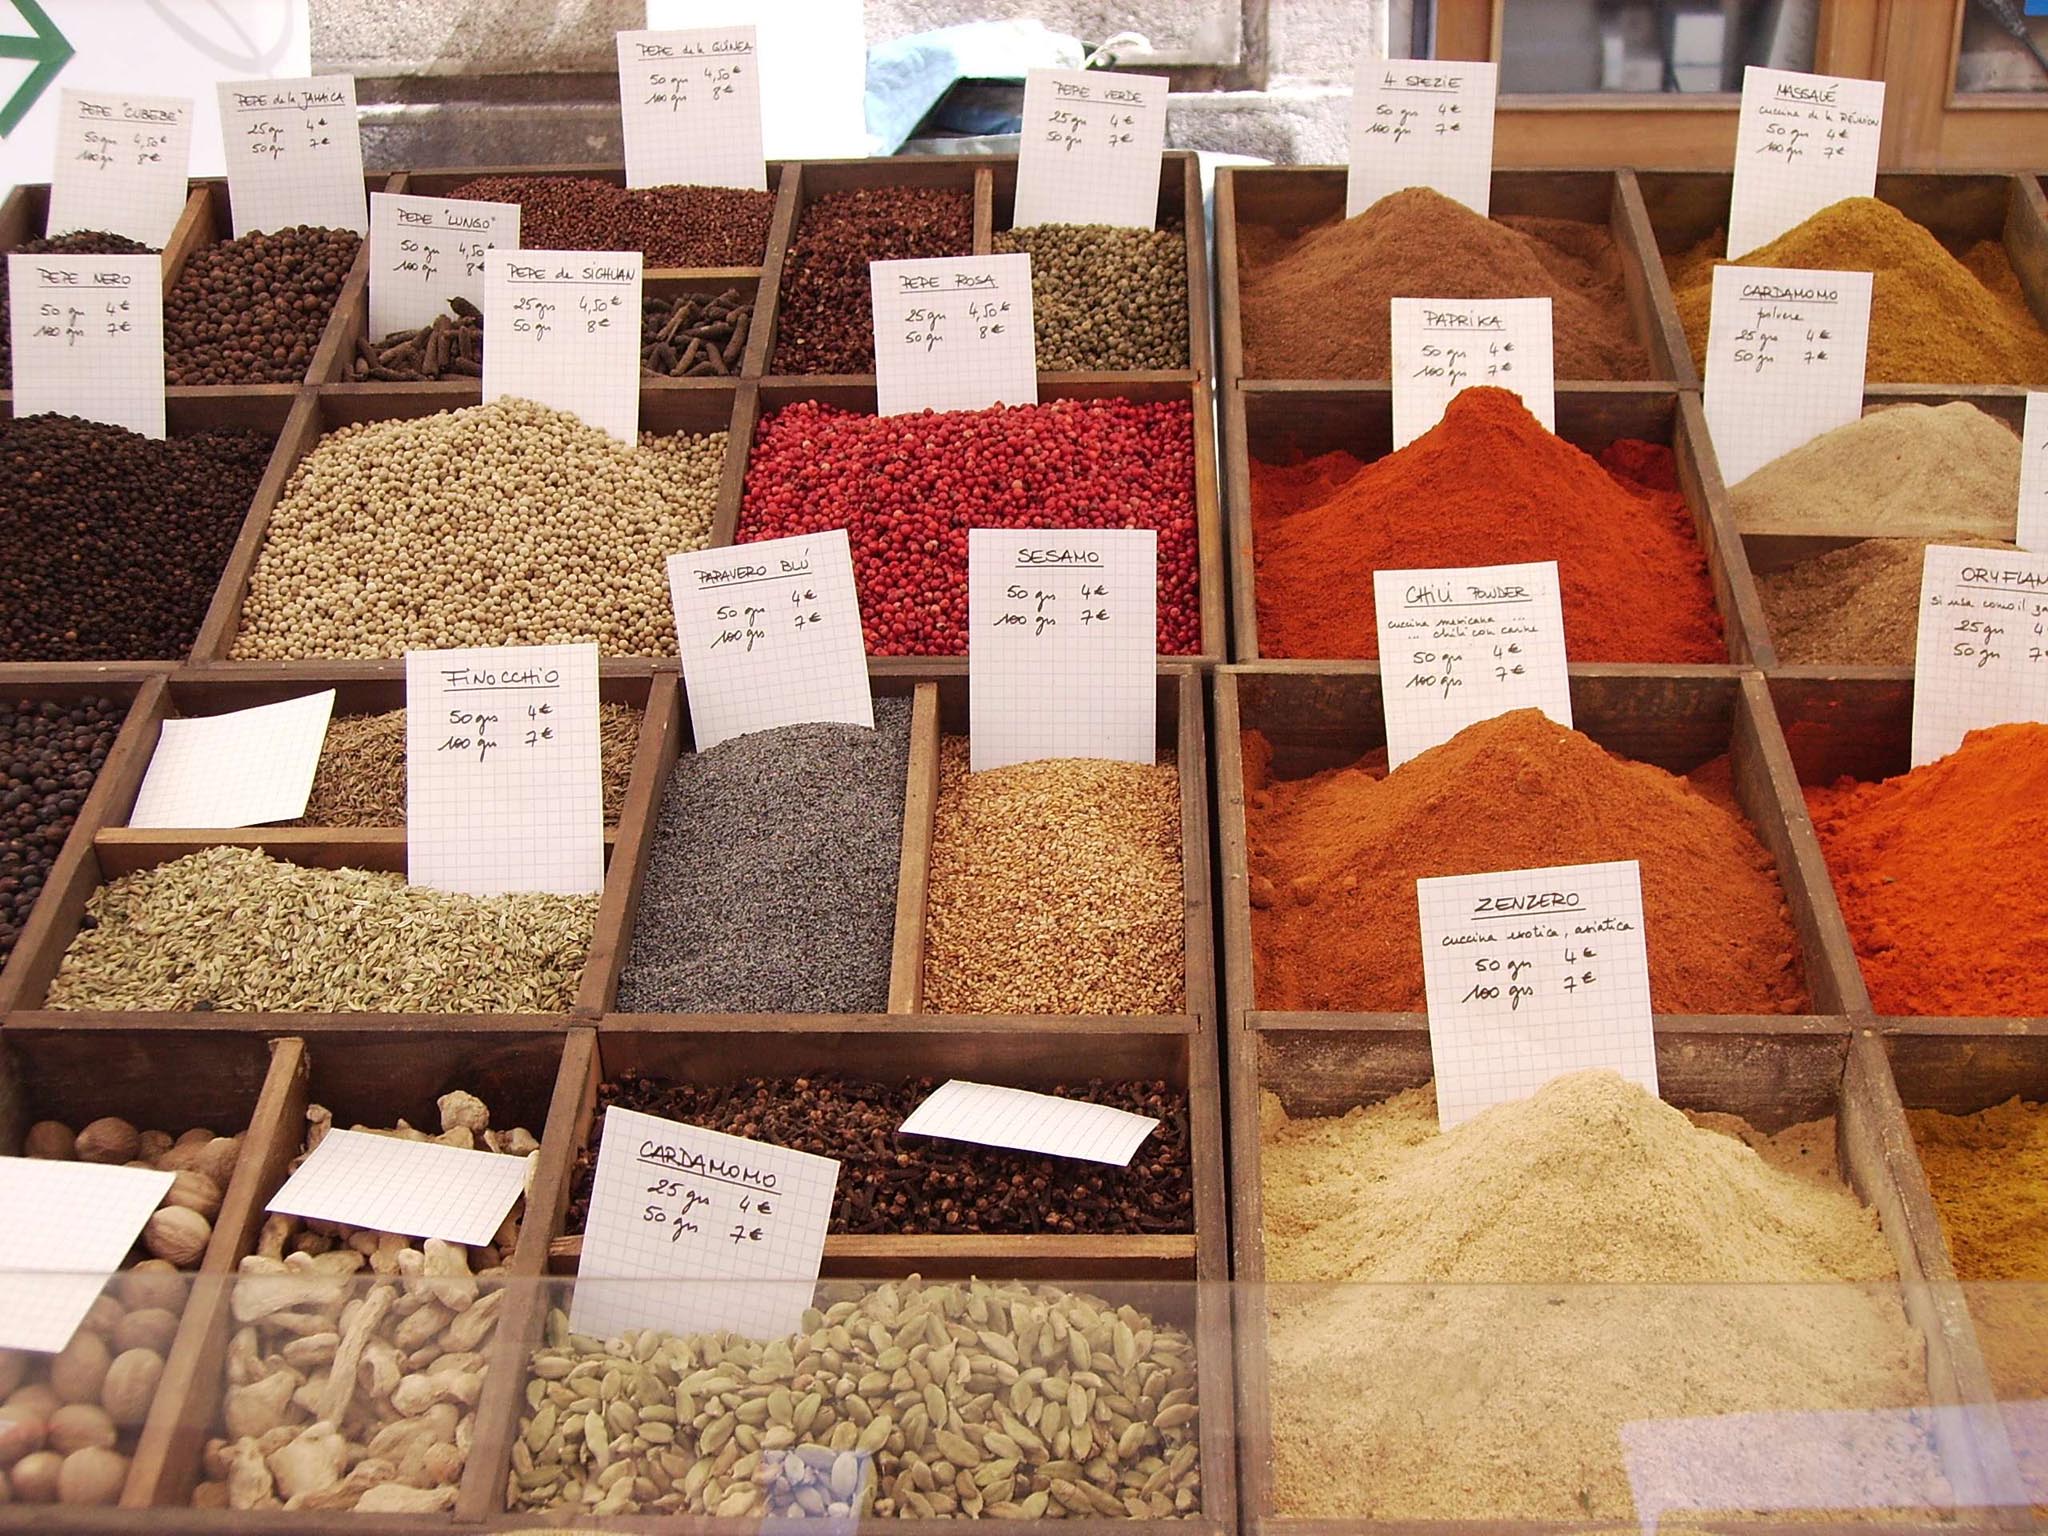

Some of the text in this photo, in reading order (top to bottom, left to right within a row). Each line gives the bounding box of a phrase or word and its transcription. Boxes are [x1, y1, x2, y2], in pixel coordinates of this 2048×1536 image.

[636, 43, 674, 56] PEPE
[650, 74, 666, 85] 50
[1384, 71, 1397, 86] 4
[1053, 80, 1143, 103] PEPE VERDE
[233, 93, 267, 107] PEPE
[1048, 110, 1072, 123] 25
[1376, 104, 1393, 115] 50
[248, 122, 269, 134] 25
[1766, 124, 1785, 135] 50
[1047, 131, 1062, 141] 50
[252, 143, 267, 153] 50
[397, 208, 433, 225] PEPE
[401, 240, 418, 252] 50
[507, 263, 546, 279] PEPE
[94, 273, 131, 285] NERO
[899, 274, 998, 289] PEPE ROSA
[1742, 284, 1839, 301] CARDAMOMO
[41, 304, 60, 316] 50
[514, 297, 538, 310] 25
[905, 309, 926, 321] 25
[1424, 310, 1503, 328] PAPRIKA
[514, 319, 531, 331] 50
[905, 331, 921, 343] 50
[1735, 329, 1756, 341] 25
[1422, 345, 1441, 357] 50
[1734, 350, 1754, 362] 50
[1412, 365, 1444, 378] 100
[1017, 548, 1100, 564] SESAMO
[693, 565, 768, 584] PAPAVERO
[1007, 585, 1028, 599] 50
[1467, 585, 1530, 600] POWDER
[717, 606, 738, 620] 50
[993, 613, 1028, 626] 100
[1954, 620, 1985, 632] 25
[2033, 623, 2048, 637] 4
[711, 629, 743, 649] 100
[1953, 642, 1975, 657] 50
[1413, 651, 1436, 664] 50
[440, 667, 560, 687] FINOCCHIO
[1405, 673, 1436, 688] 100
[449, 709, 473, 724] 50
[437, 735, 471, 751] 100
[1474, 892, 1580, 912] ZENZERO
[1574, 917, 1635, 935] asiatica
[1475, 958, 1501, 973] 50
[1461, 984, 1500, 1004] 100
[639, 1140, 777, 1188] CARDAMOMO
[647, 1179, 684, 1197] 25
[643, 1205, 667, 1222] 50
